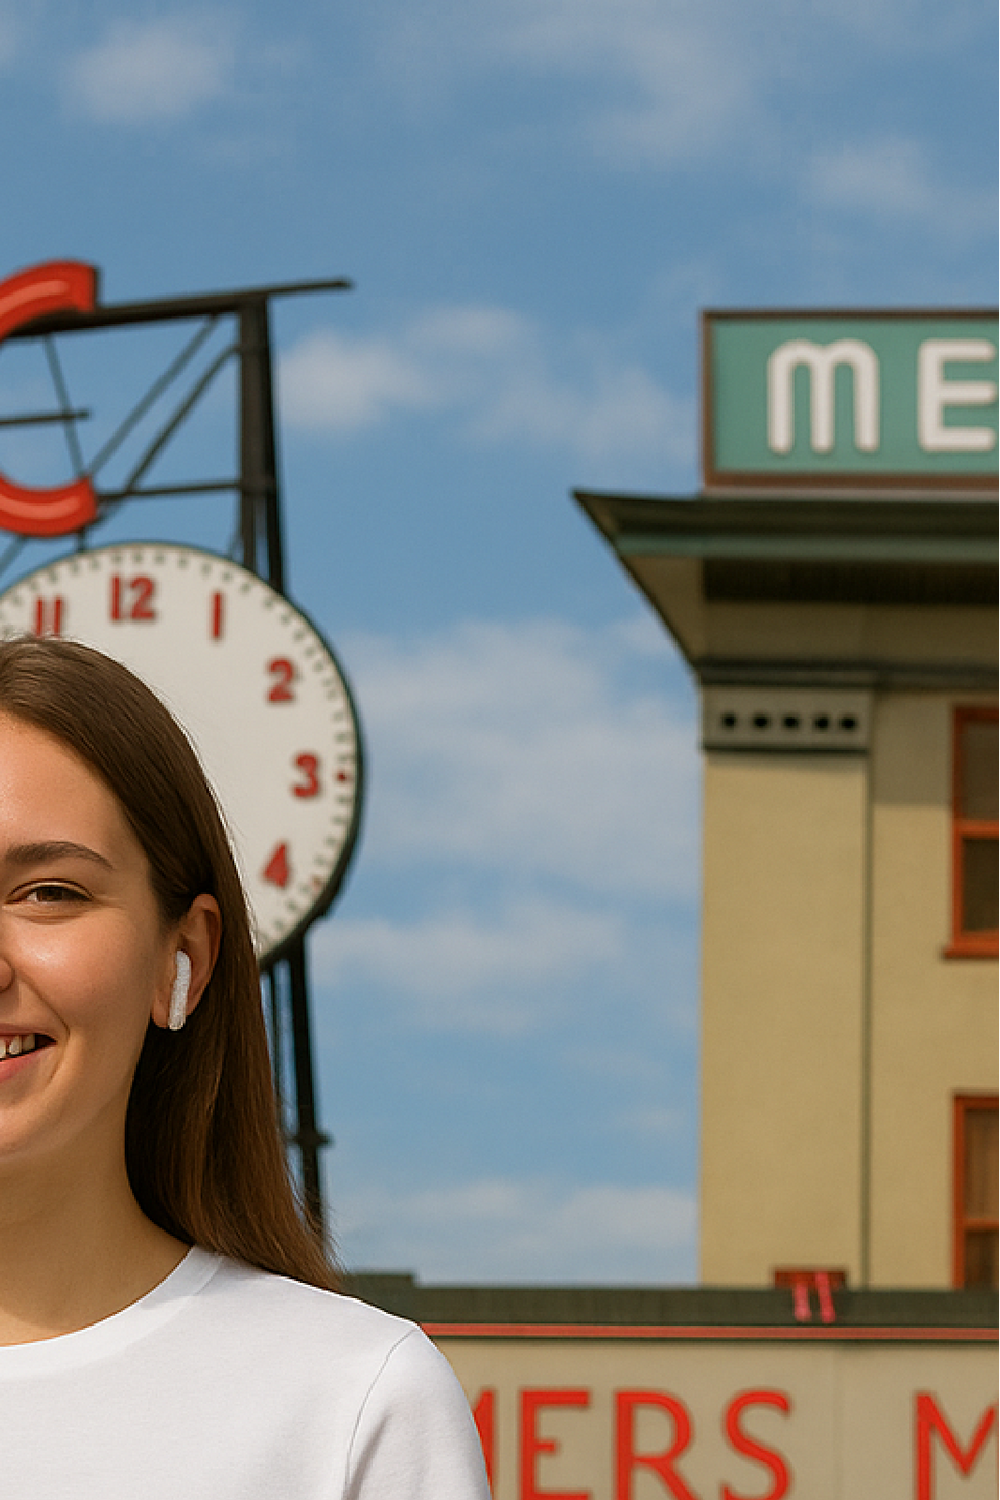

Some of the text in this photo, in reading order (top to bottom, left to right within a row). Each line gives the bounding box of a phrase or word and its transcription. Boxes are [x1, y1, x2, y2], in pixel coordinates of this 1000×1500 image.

[766, 337, 998, 454] ME
[34, 595, 63, 638] 11
[110, 574, 156, 621] 12
[210, 591, 224, 639] 1
[267, 657, 295, 703] 2
[292, 752, 321, 799] 3
[261, 841, 291, 889] 4
